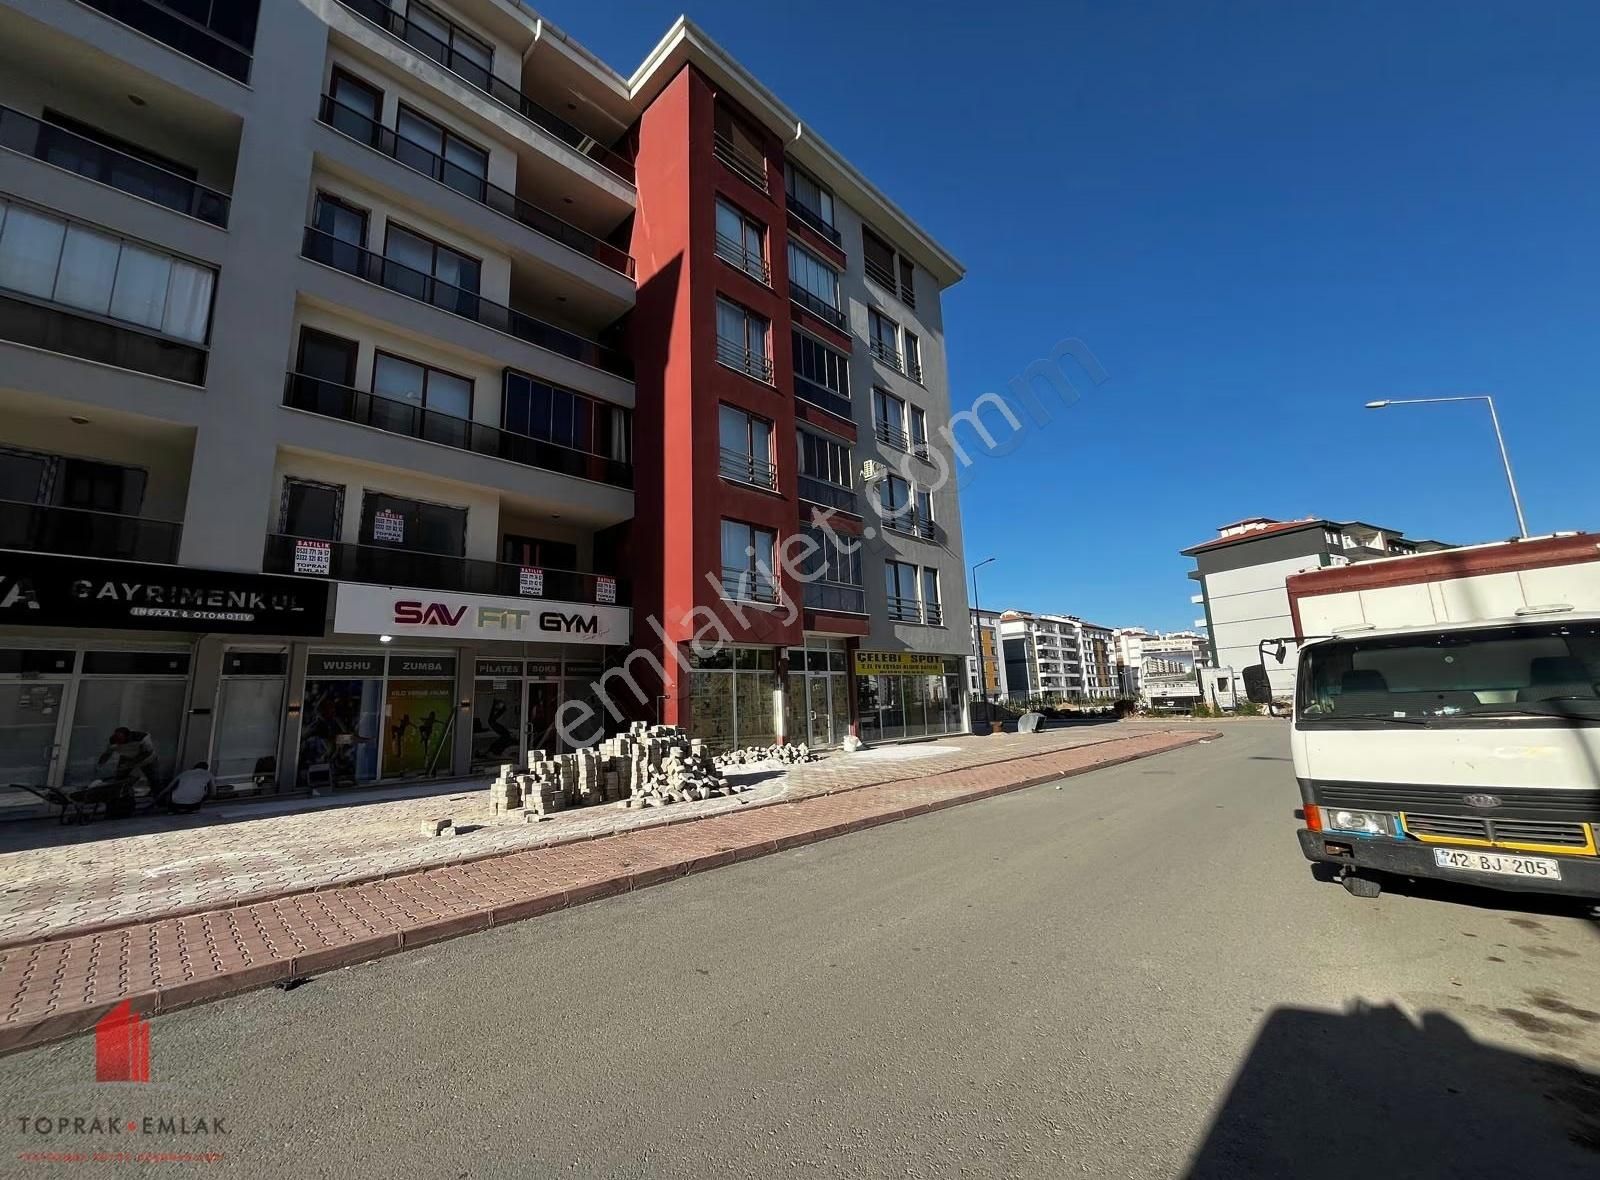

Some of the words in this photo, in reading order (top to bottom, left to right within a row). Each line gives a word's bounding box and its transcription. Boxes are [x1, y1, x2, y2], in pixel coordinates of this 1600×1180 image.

[297, 540, 330, 548] SATILIK
[0, 576, 41, 609] A
[394, 601, 468, 626] SAV
[539, 611, 598, 633] GYM
[911, 654, 940, 664] SPOT
[323, 661, 371, 671] WUSHU
[402, 662, 442, 671] ZUMBA
[1449, 853, 1470, 867] 42
[1480, 856, 1502, 871] BJ
[1513, 859, 1548, 875] 205
